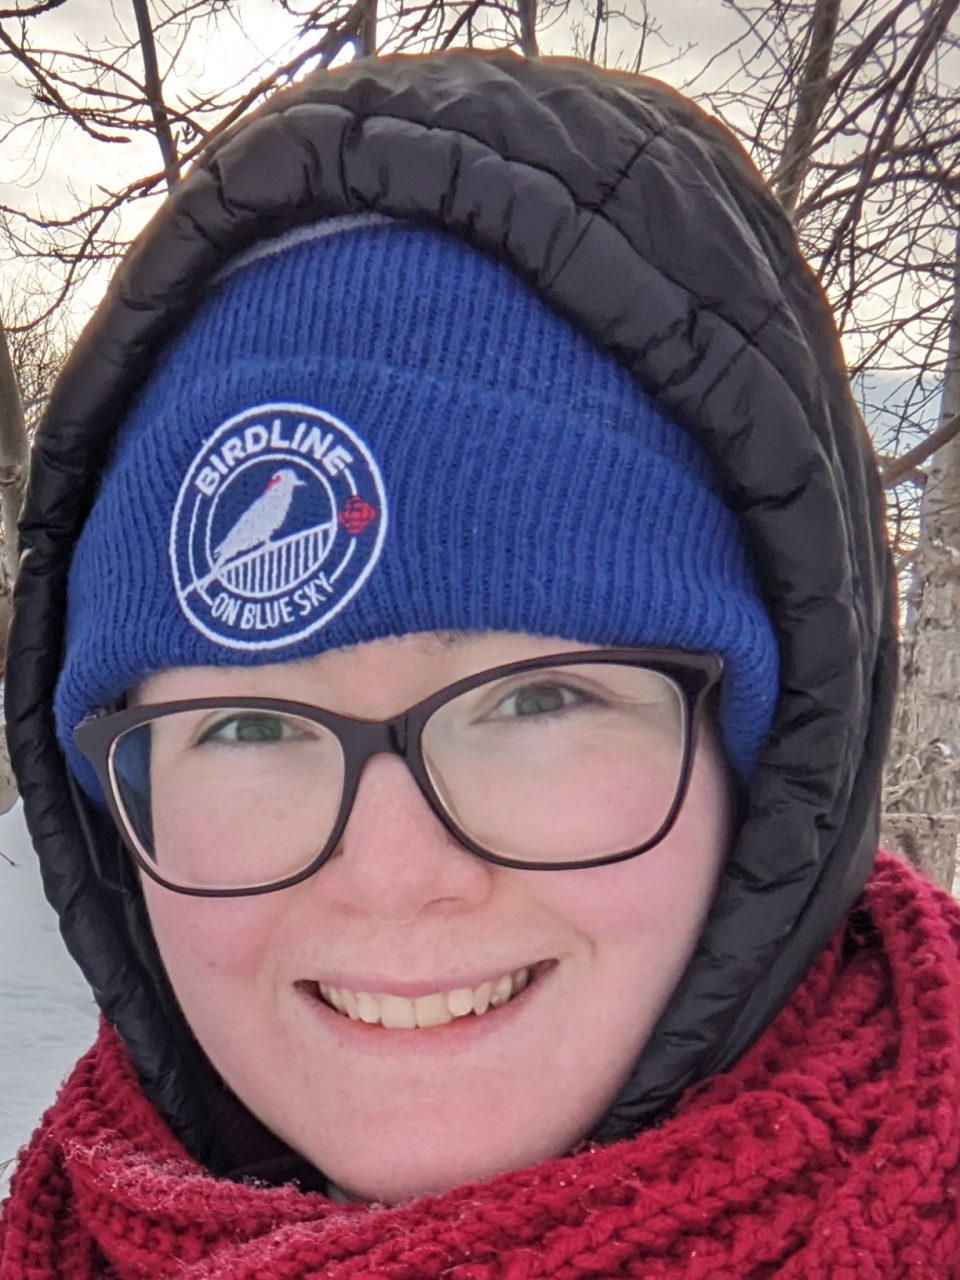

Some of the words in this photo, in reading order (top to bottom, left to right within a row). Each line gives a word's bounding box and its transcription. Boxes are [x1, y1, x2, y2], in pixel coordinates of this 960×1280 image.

[195, 418, 353, 496] BIRDLINE
[211, 592, 242, 626] ON
[240, 596, 295, 630] BLUE
[293, 571, 334, 616] SKY
